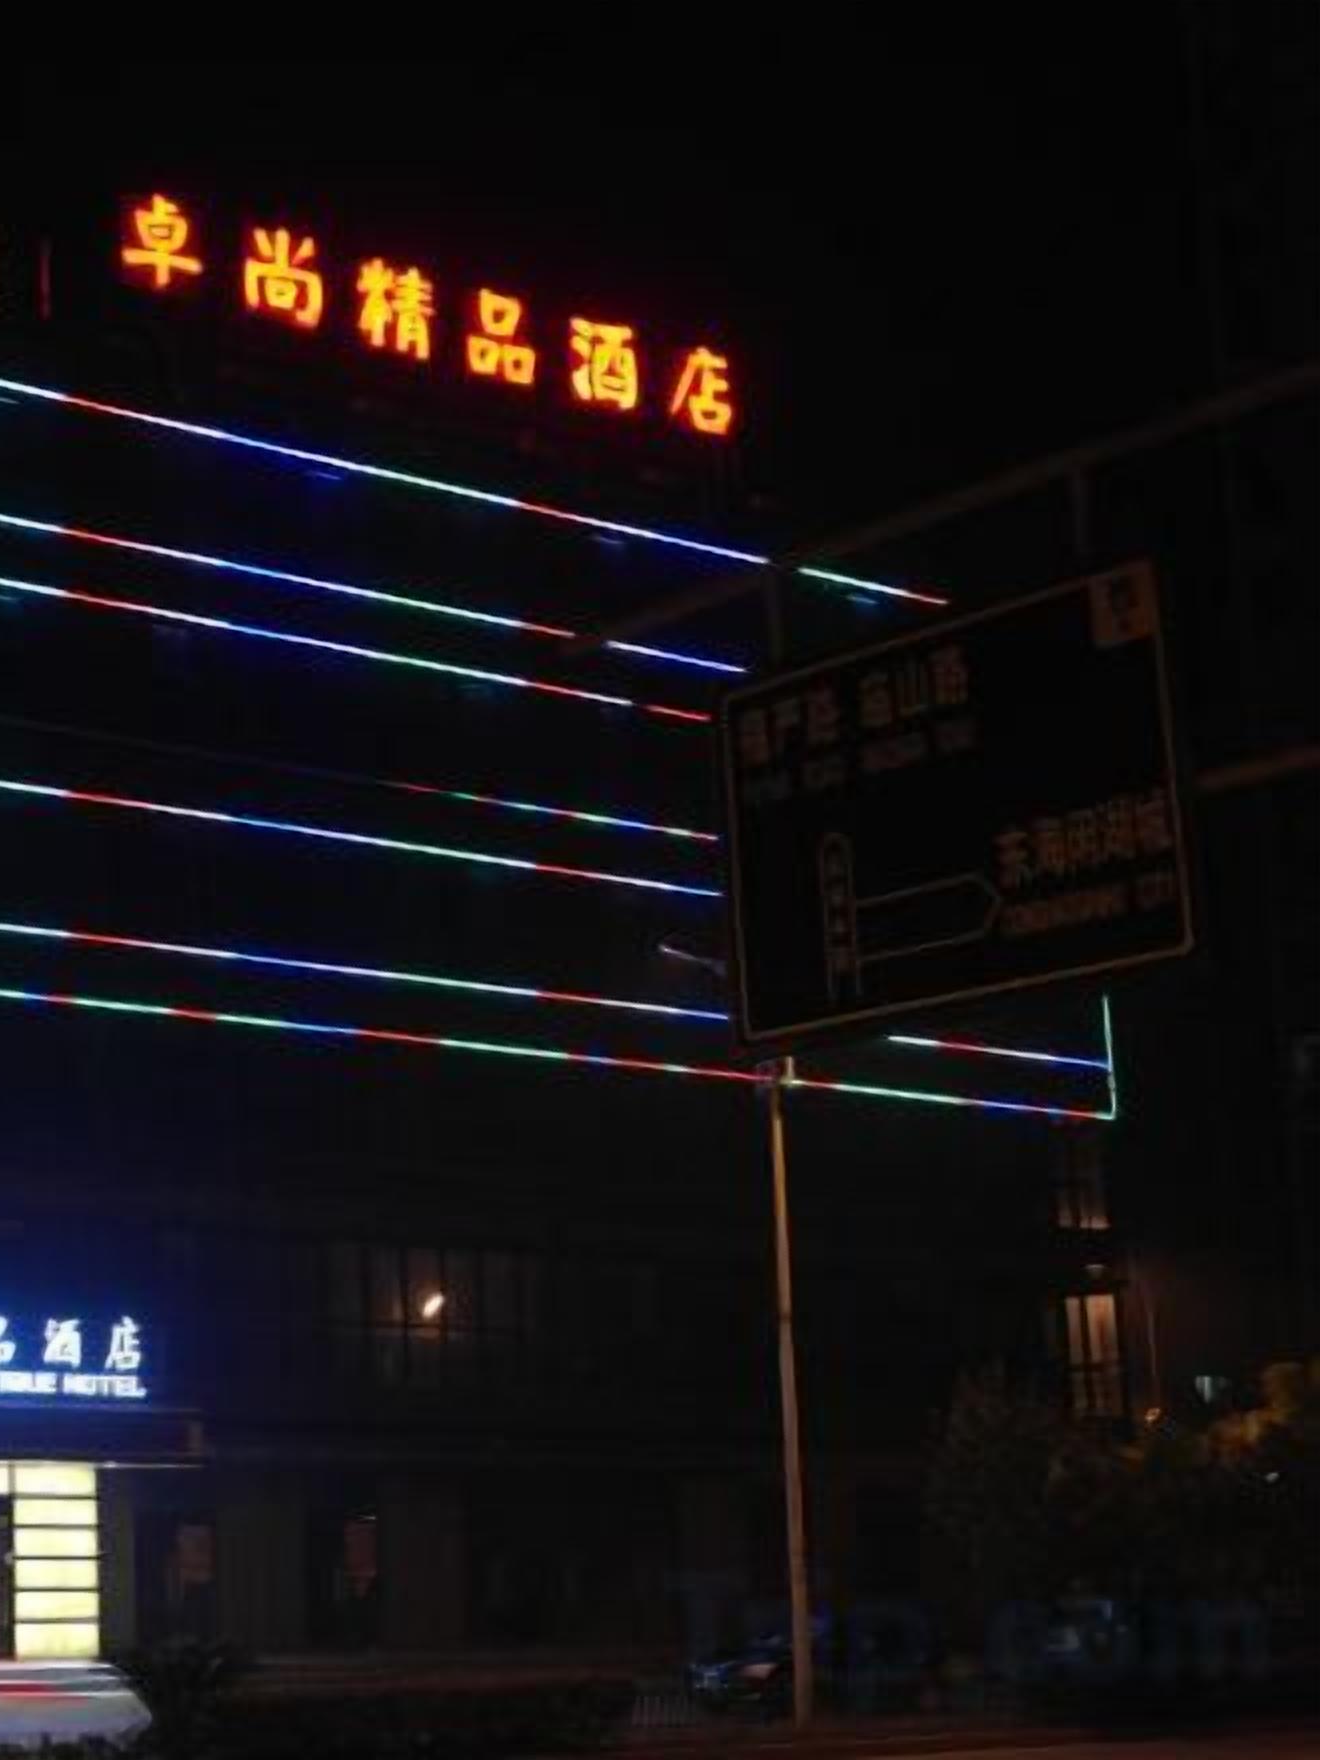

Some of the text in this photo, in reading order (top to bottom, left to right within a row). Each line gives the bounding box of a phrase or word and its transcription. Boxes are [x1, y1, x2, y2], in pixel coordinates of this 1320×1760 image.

[121, 194, 734, 436] 卓尚精品酒店
[62, 1372, 147, 1399] HOTEL
